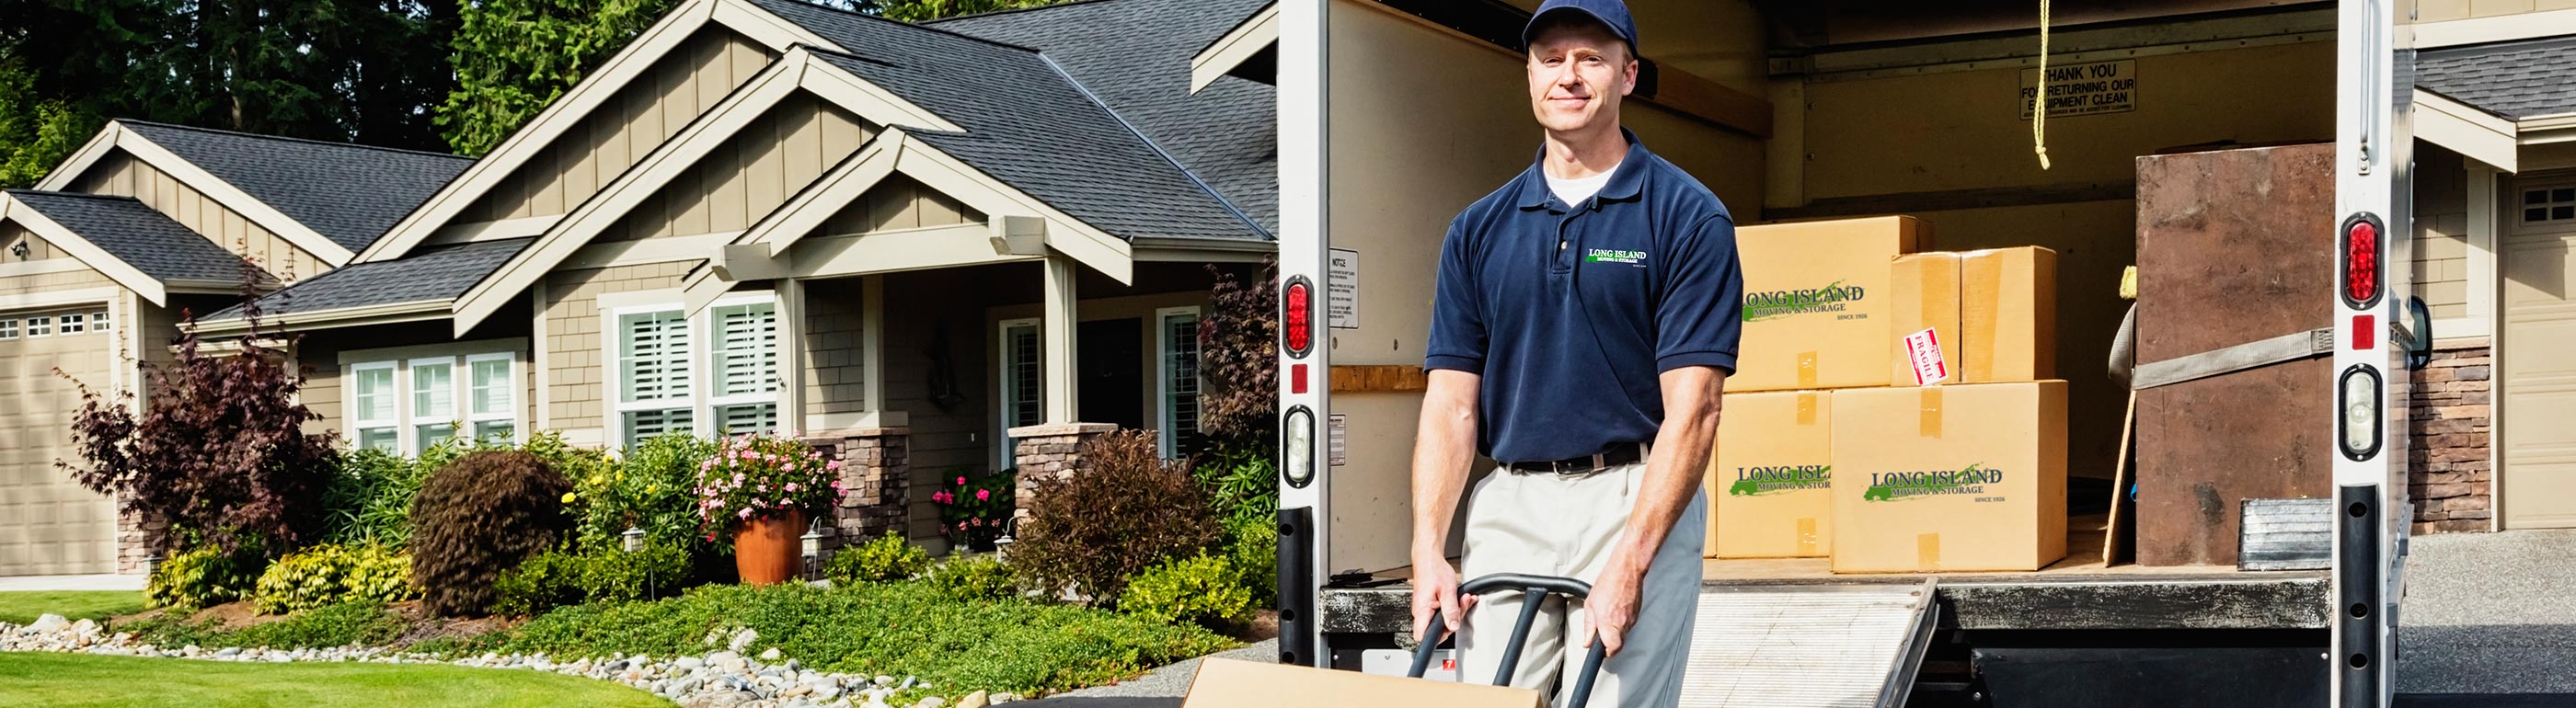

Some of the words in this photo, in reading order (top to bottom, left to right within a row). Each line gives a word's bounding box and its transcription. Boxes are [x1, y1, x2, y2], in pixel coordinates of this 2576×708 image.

[2044, 66, 2084, 82] HANK
[2089, 63, 2117, 78] YOU
[2047, 81, 2108, 97] RETURNING
[2110, 78, 2134, 91] OUR
[2028, 95, 2088, 110] EUIPMENT
[2092, 92, 2128, 106] CLEAN
[1589, 248, 1614, 257] LONG
[1615, 249, 1647, 259] ISLAND
[1742, 291, 1788, 307] ONG
[1793, 286, 1864, 305] ISLAND
[1753, 306, 1792, 317] MOVING
[1794, 306, 1801, 314] &
[1803, 303, 1846, 314] STORAGE
[1915, 336, 1935, 380] FRAGILE
[1737, 465, 1791, 482] LONG
[1871, 472, 1926, 487] LONG
[1931, 469, 2003, 485] ISLAND
[1757, 481, 1796, 491] MOVING
[1798, 481, 1805, 489] &
[1892, 487, 1930, 497] MOVING
[1941, 485, 1984, 495] STORAGE
[1446, 660, 1454, 668] 7
